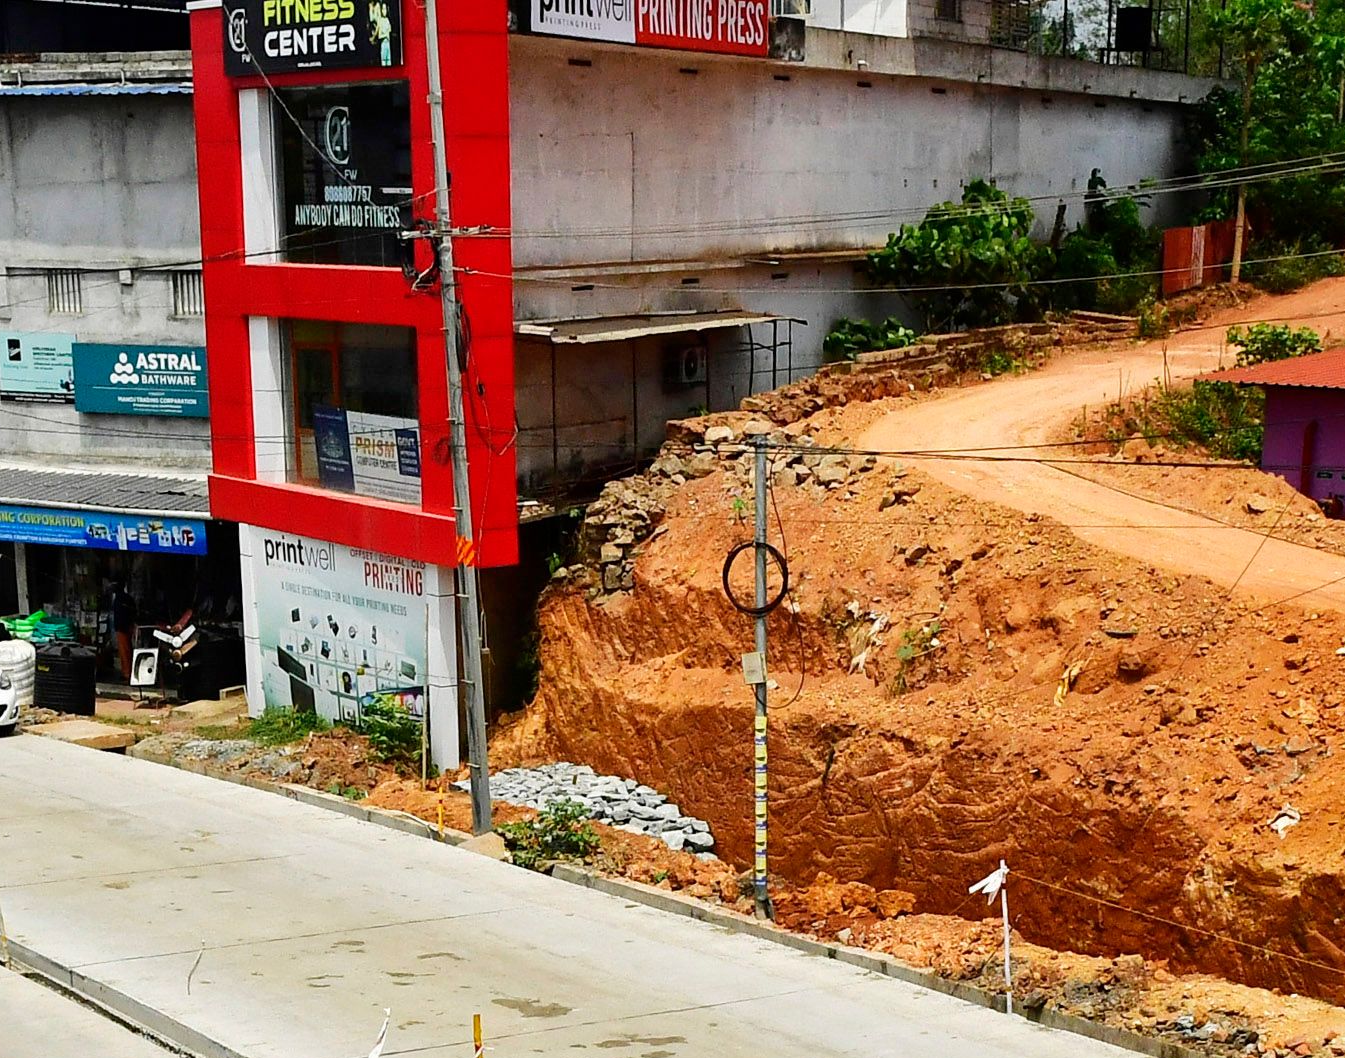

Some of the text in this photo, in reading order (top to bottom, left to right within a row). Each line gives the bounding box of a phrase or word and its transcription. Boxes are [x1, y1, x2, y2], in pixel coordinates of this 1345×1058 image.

[263, 0, 355, 26] FITNESS
[638, 0, 764, 45] PRINTING PRESS
[264, 24, 356, 57] CENTER
[295, 204, 401, 228] ANYBODY CAN DO FITNESS
[136, 351, 202, 371] ASTRAL
[141, 374, 197, 386] BATHWARE
[355, 436, 395, 459] PRISM
[17, 512, 84, 527] CORPORATION
[264, 535, 336, 571] printwell
[364, 561, 423, 596] PRINTING
